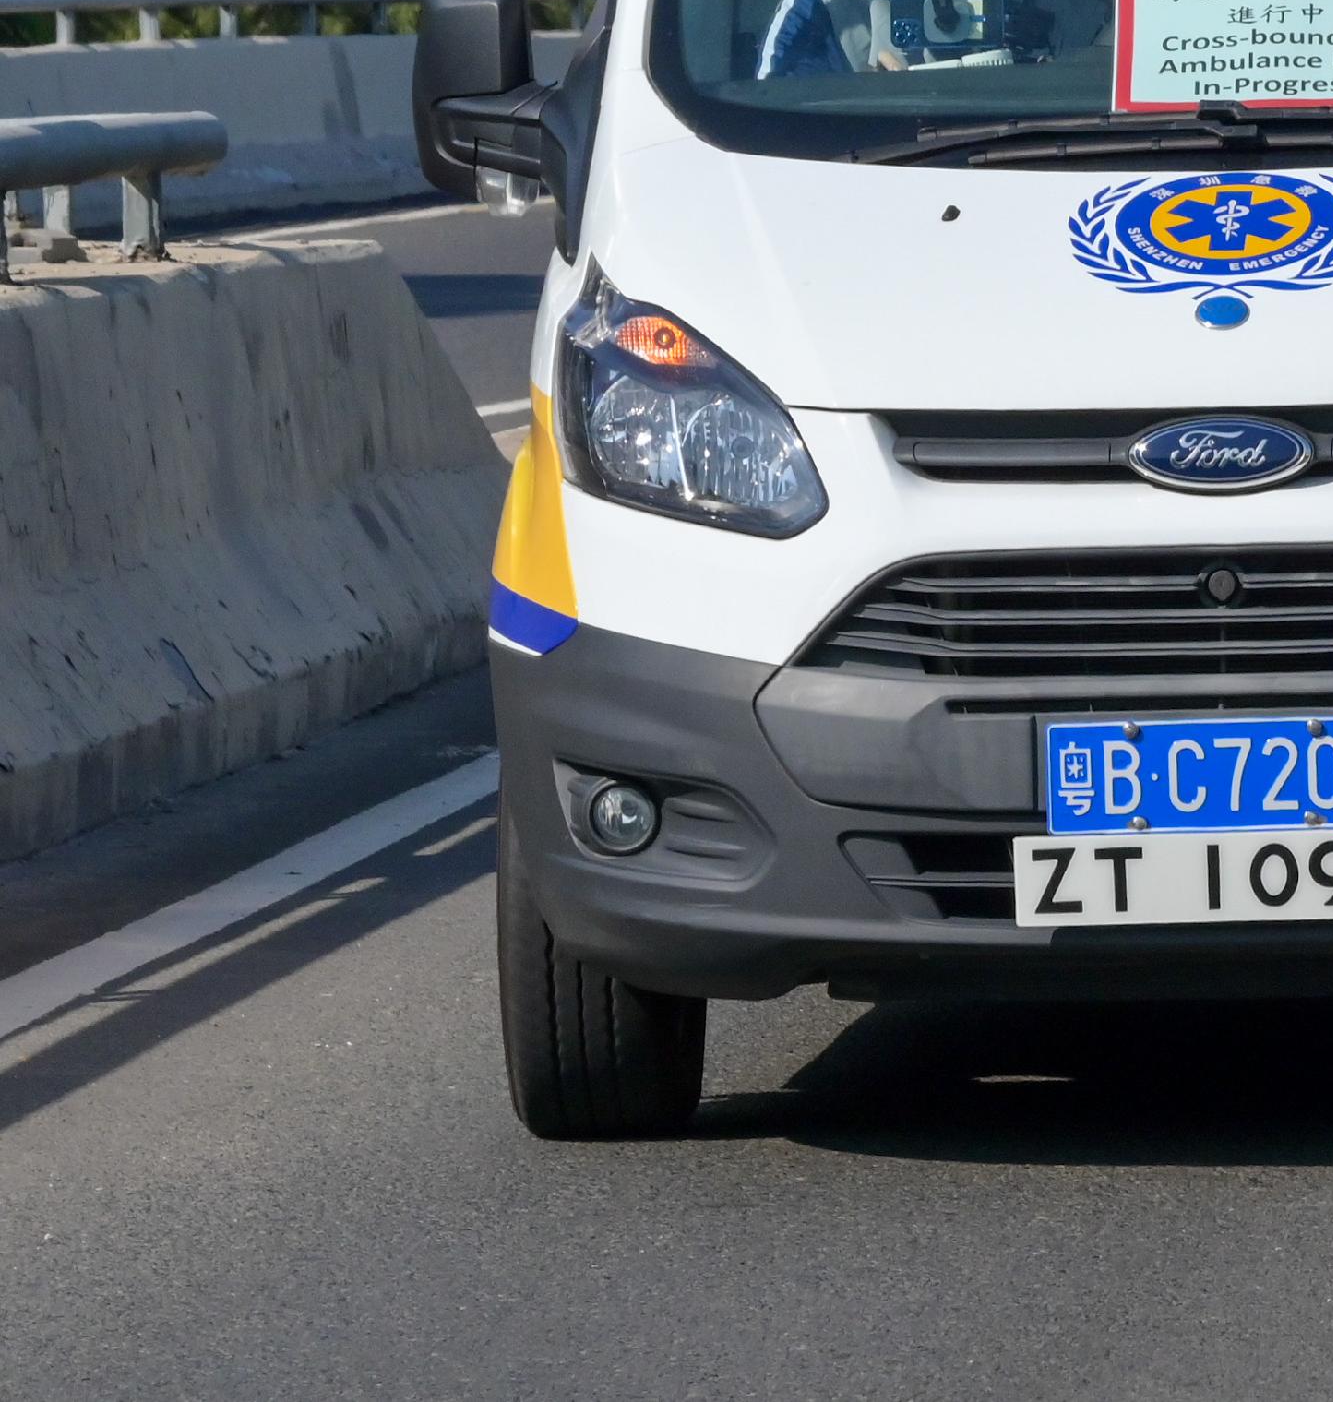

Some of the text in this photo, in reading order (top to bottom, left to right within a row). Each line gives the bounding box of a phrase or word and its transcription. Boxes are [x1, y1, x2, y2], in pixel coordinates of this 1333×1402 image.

[1227, 3, 1324, 24] 進行中
[1159, 52, 1323, 74] Ambulance
[1127, 224, 1330, 272] SHENZHEN EMERGENCY
[1170, 429, 1269, 469] Ford
[1031, 846, 1143, 915] ZT
